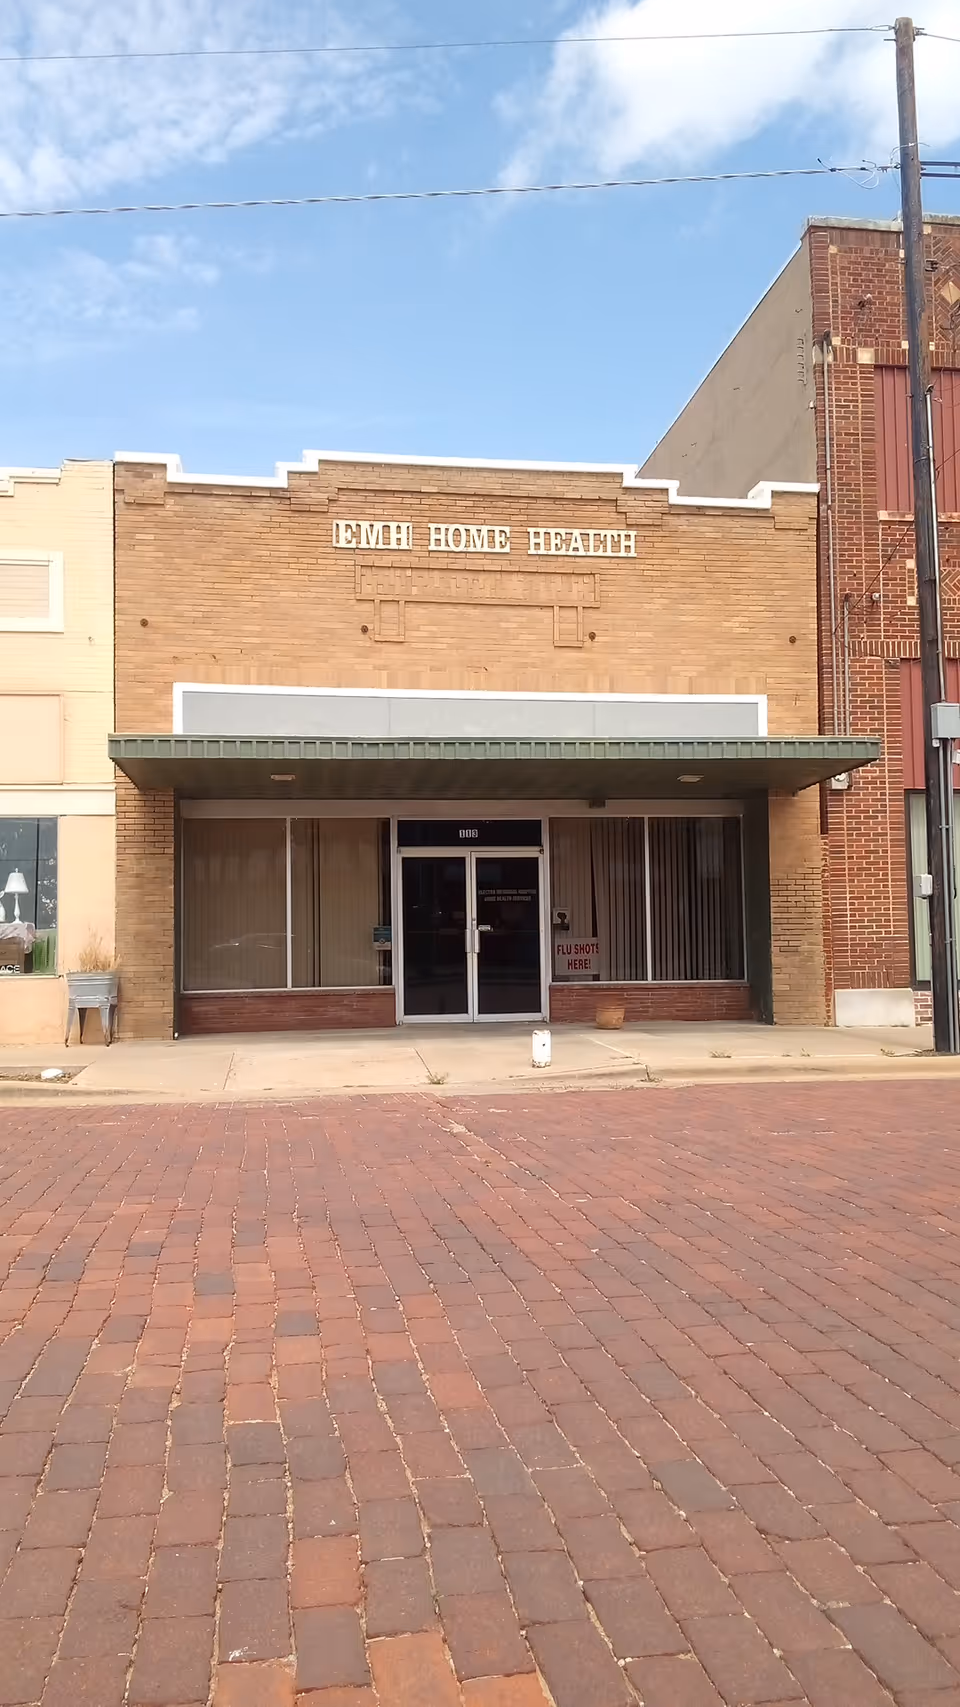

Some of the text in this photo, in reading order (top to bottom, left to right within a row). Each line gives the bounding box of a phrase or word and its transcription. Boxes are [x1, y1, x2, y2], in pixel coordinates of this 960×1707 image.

[332, 520, 637, 558] EMH HOME HEALTH
[459, 829, 479, 838] 113
[556, 942, 600, 955] FLU SHOTS
[567, 958, 592, 970] HERE!
